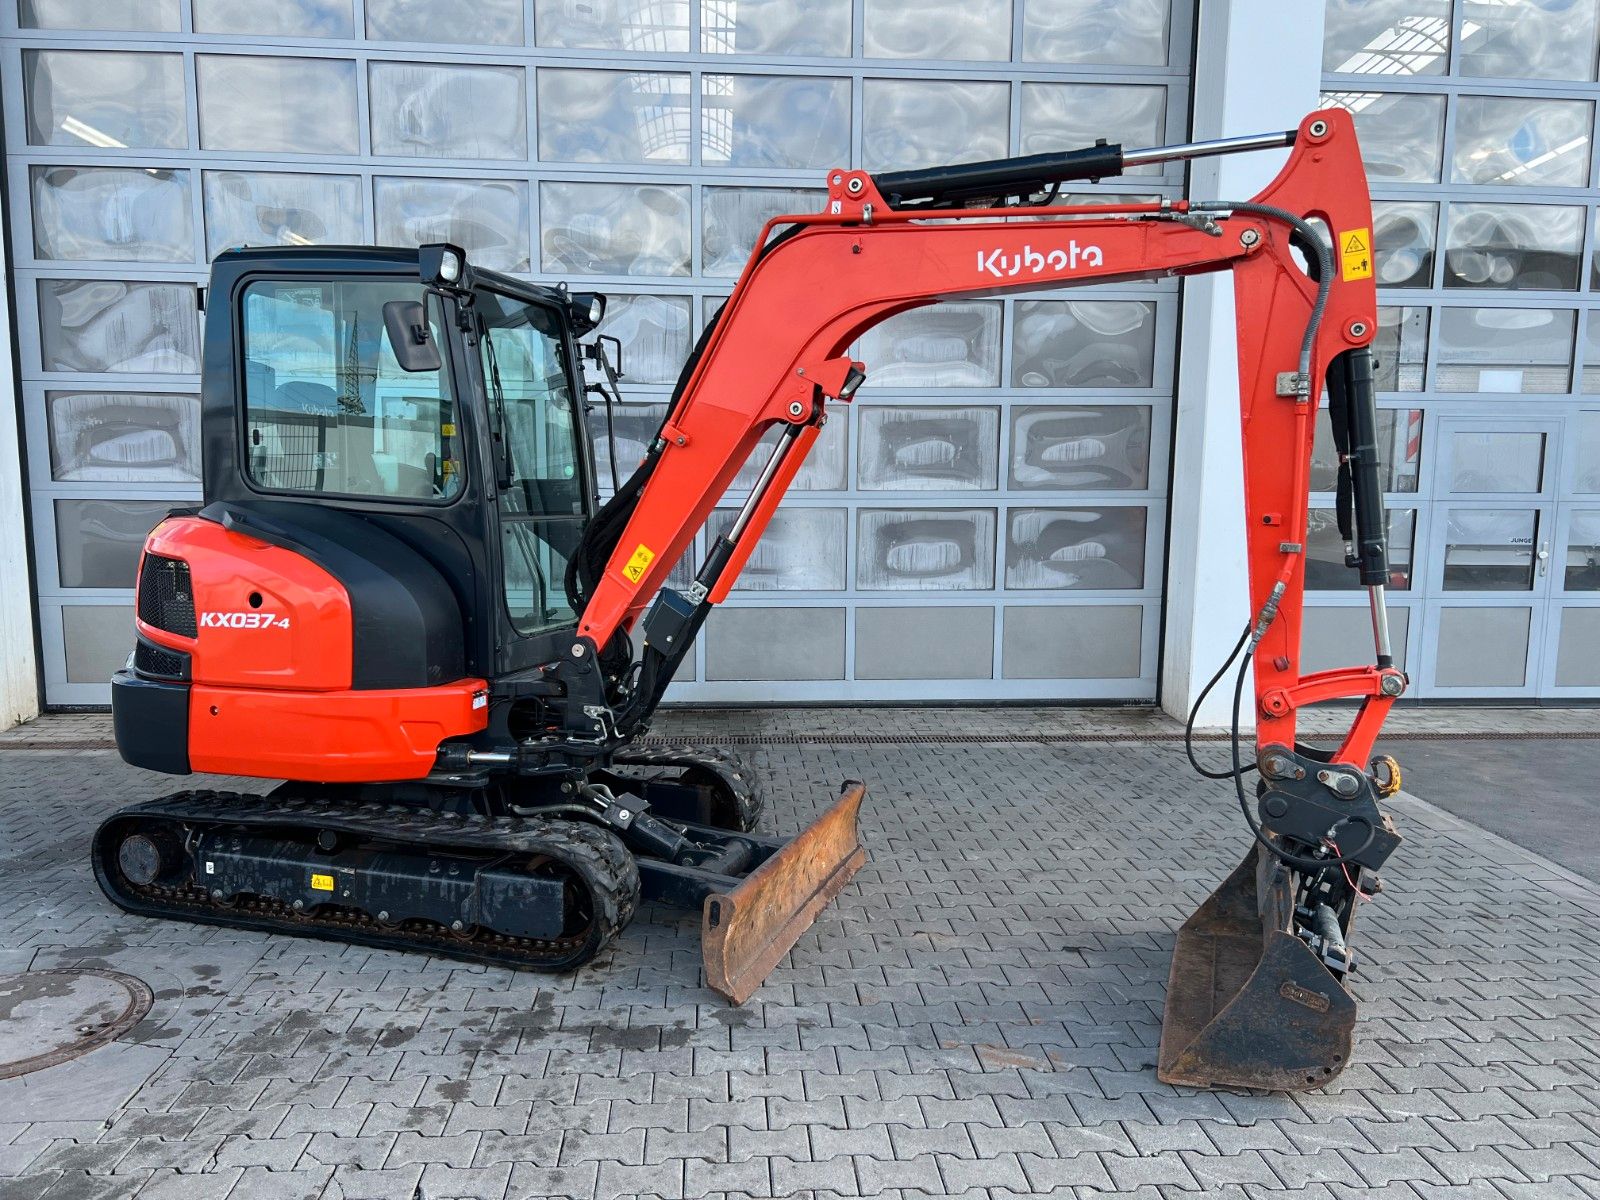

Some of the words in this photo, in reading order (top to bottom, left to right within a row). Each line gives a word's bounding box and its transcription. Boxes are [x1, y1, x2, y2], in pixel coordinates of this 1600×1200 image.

[977, 239, 1103, 277] Kubota
[301, 402, 335, 417] Kubota
[200, 612, 290, 629] KX037-4
